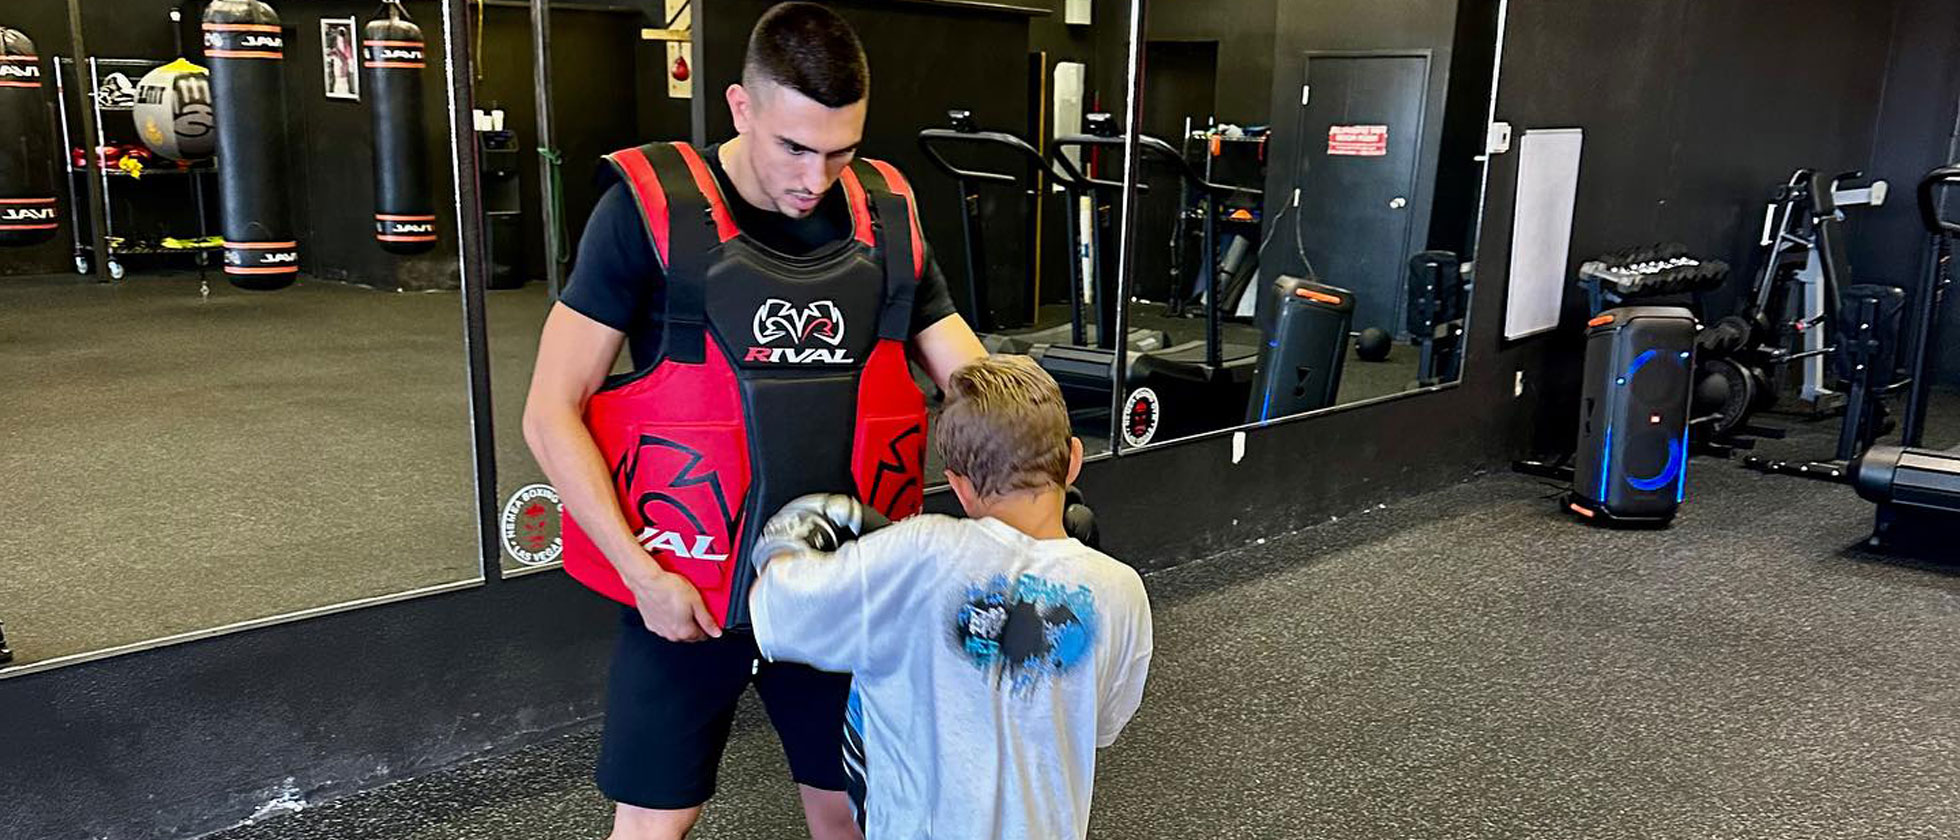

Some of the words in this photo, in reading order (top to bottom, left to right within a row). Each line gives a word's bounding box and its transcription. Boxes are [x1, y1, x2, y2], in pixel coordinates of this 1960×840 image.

[743, 346, 854, 363] RIVAL
[521, 488, 559, 503] BOXING
[513, 545, 532, 561] LAS
